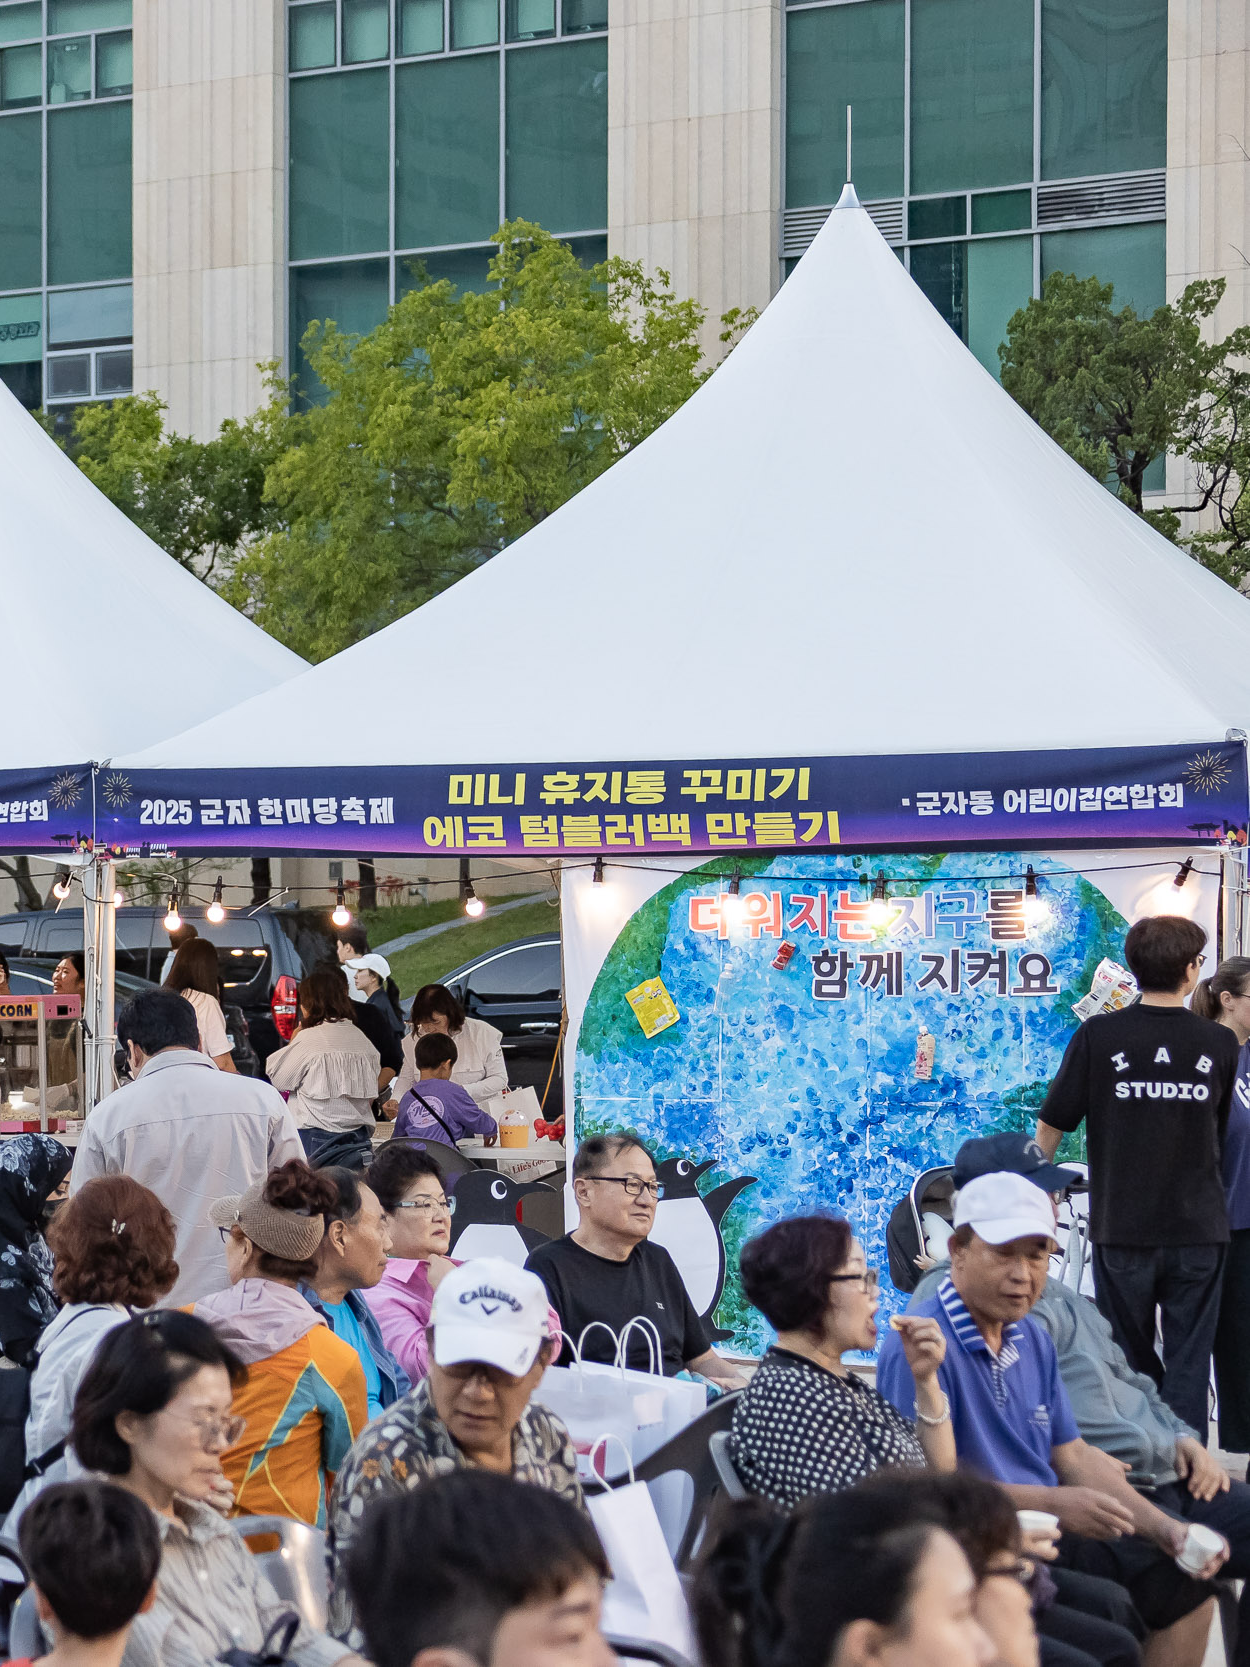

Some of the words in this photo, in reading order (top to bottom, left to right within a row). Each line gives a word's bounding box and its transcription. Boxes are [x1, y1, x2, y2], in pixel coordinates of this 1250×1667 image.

[449, 772, 525, 806] 미니
[540, 770, 666, 805] 휴지통
[680, 767, 810, 802] 꾸미기
[1003, 783, 1184, 813] 어린이집연합회
[140, 799, 192, 825] 2025
[200, 799, 251, 825] 군자
[258, 797, 395, 825] 한마당축제
[423, 816, 507, 848] 에코
[520, 813, 691, 847] 텀블러백
[706, 811, 840, 845] 만들기
[812, 949, 903, 999] 함께
[919, 949, 1059, 996] 지켜요
[1115, 1082, 1209, 1101] STUDIO
[459, 1285, 523, 1312] Callaway
